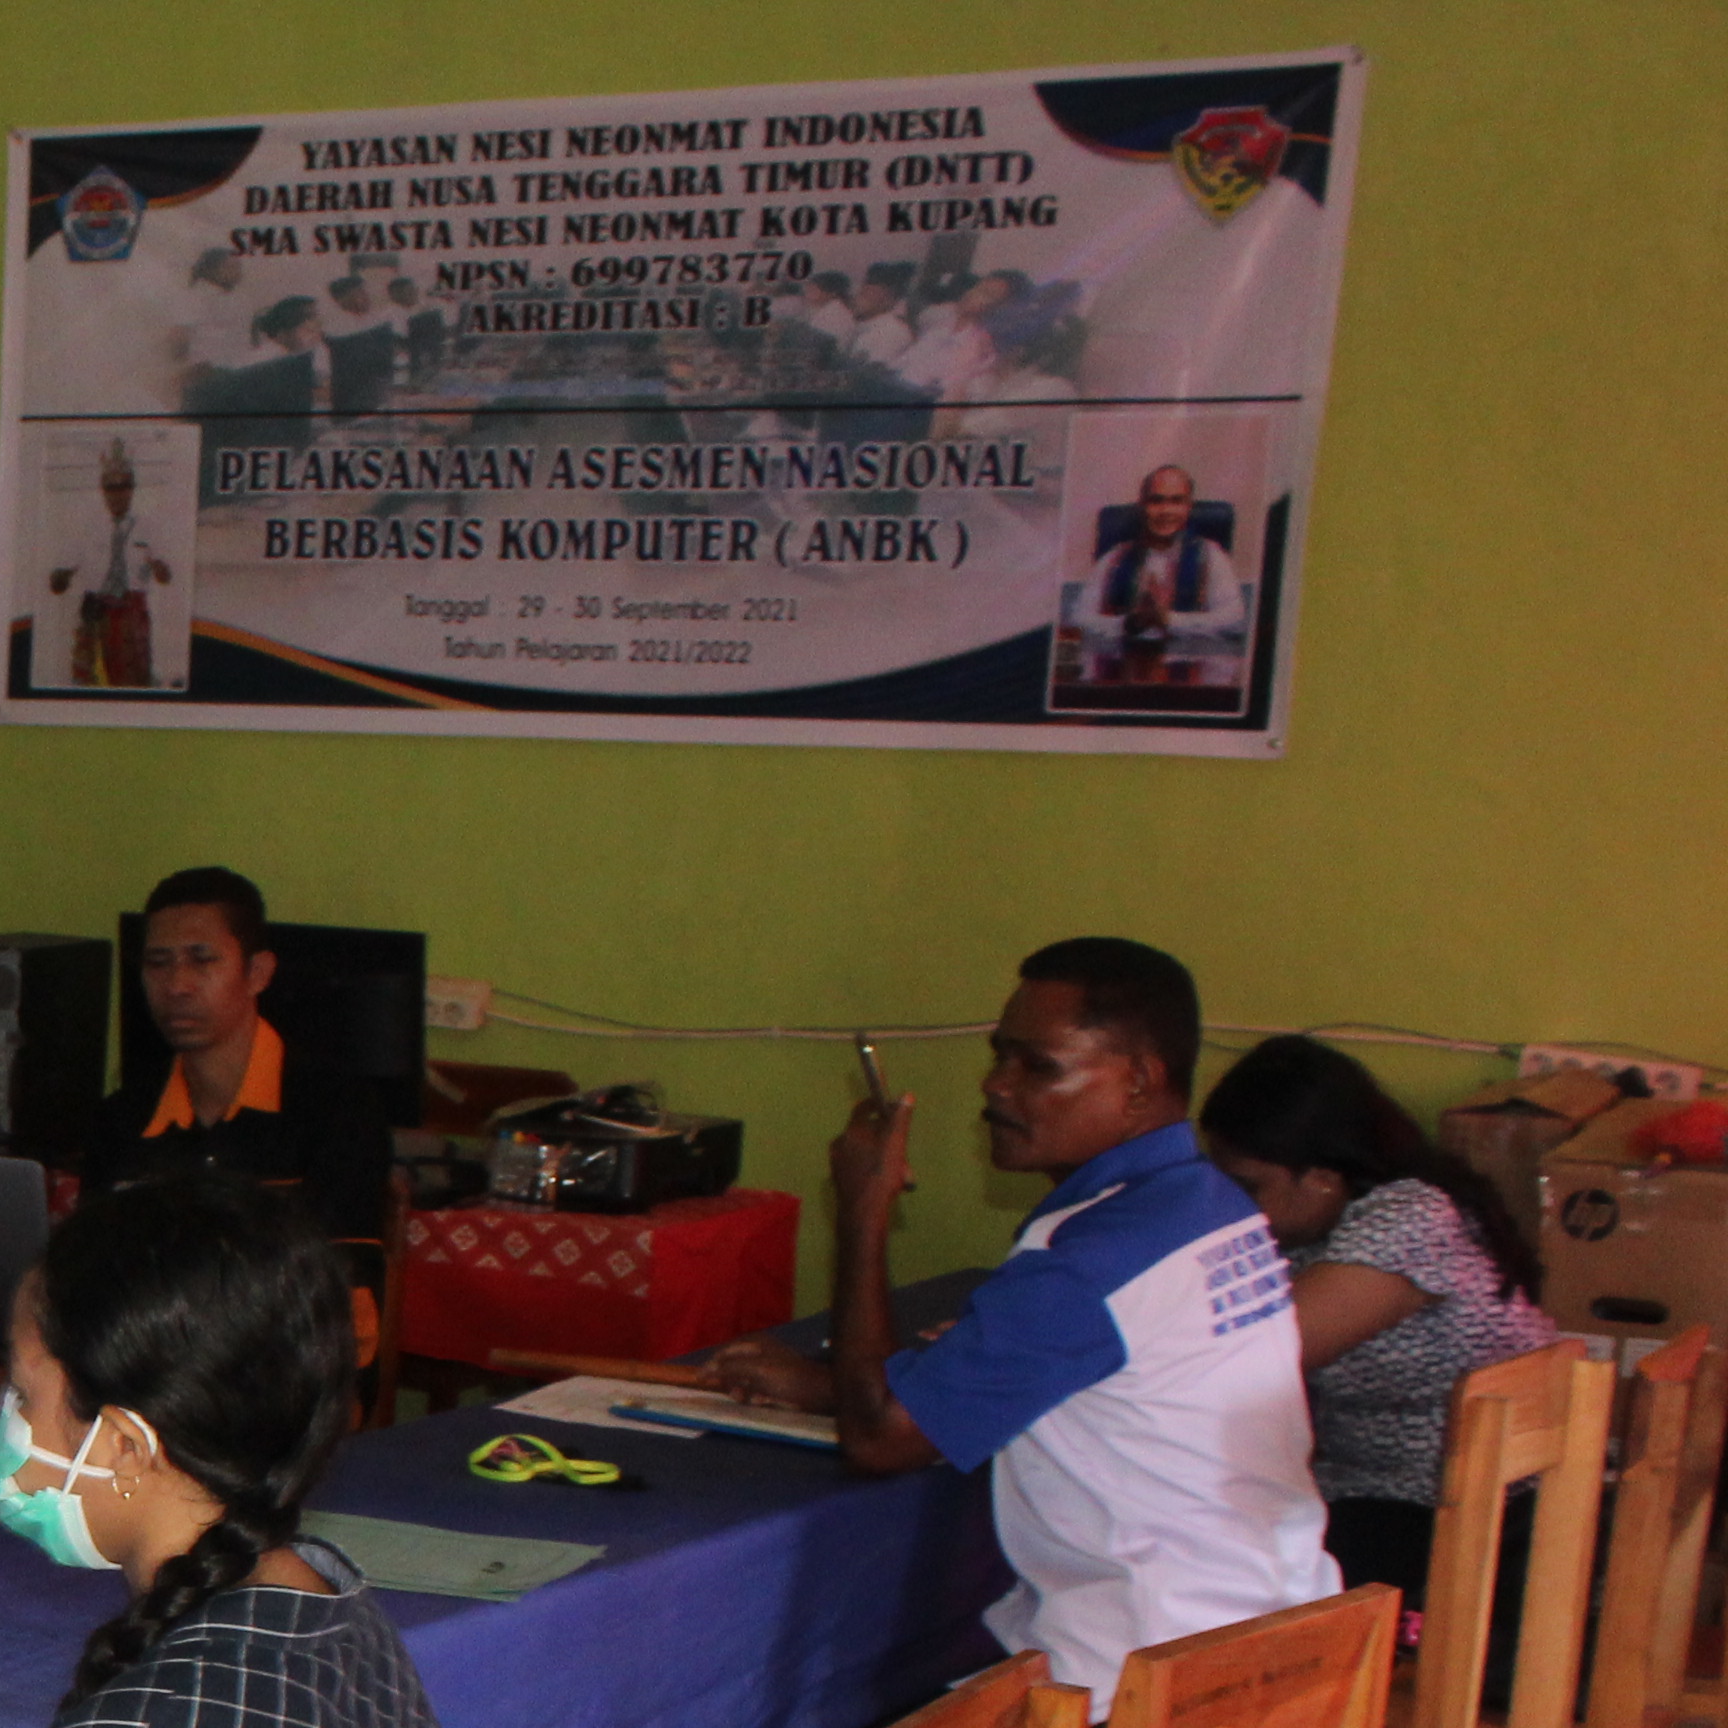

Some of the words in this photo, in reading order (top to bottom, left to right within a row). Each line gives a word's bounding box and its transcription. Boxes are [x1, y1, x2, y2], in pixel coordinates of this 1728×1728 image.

[301, 134, 458, 171] YAYASAN
[471, 129, 552, 163] NESI
[566, 118, 749, 158] NEONMAT
[763, 105, 985, 149] INDONESIA
[244, 179, 394, 215] DAERAH
[408, 175, 497, 208] NUSA
[512, 164, 723, 204] TENGGARA
[739, 158, 871, 194] TIMUR
[885, 150, 1035, 192] (DNTT)
[230, 226, 299, 256] SMA
[313, 219, 453, 254] SWASTA
[469, 215, 548, 248] NESI
[562, 207, 745, 245] NEONMAT
[759, 202, 870, 238] KOTA
[887, 194, 1059, 232] KUPANG
[436, 259, 530, 291] NPSN
[570, 249, 813, 288] 699783770
[466, 297, 702, 335] AKREDITASI
[744, 296, 772, 327] B
[218, 446, 535, 492] PELAKSANAAN
[547, 445, 767, 489] ASESMEN
[785, 442, 1035, 489] NASIONAL
[264, 517, 484, 560] BERBASIS
[497, 517, 759, 561] KOMPUTER
[801, 518, 939, 562] ANBK
[404, 593, 489, 623] Tanggal
[574, 595, 602, 619] 30
[612, 597, 731, 623] September
[744, 597, 798, 621] 2021
[443, 635, 506, 661] Tahun
[515, 636, 618, 666] Pelajaran
[629, 639, 752, 664] 2021/2022
